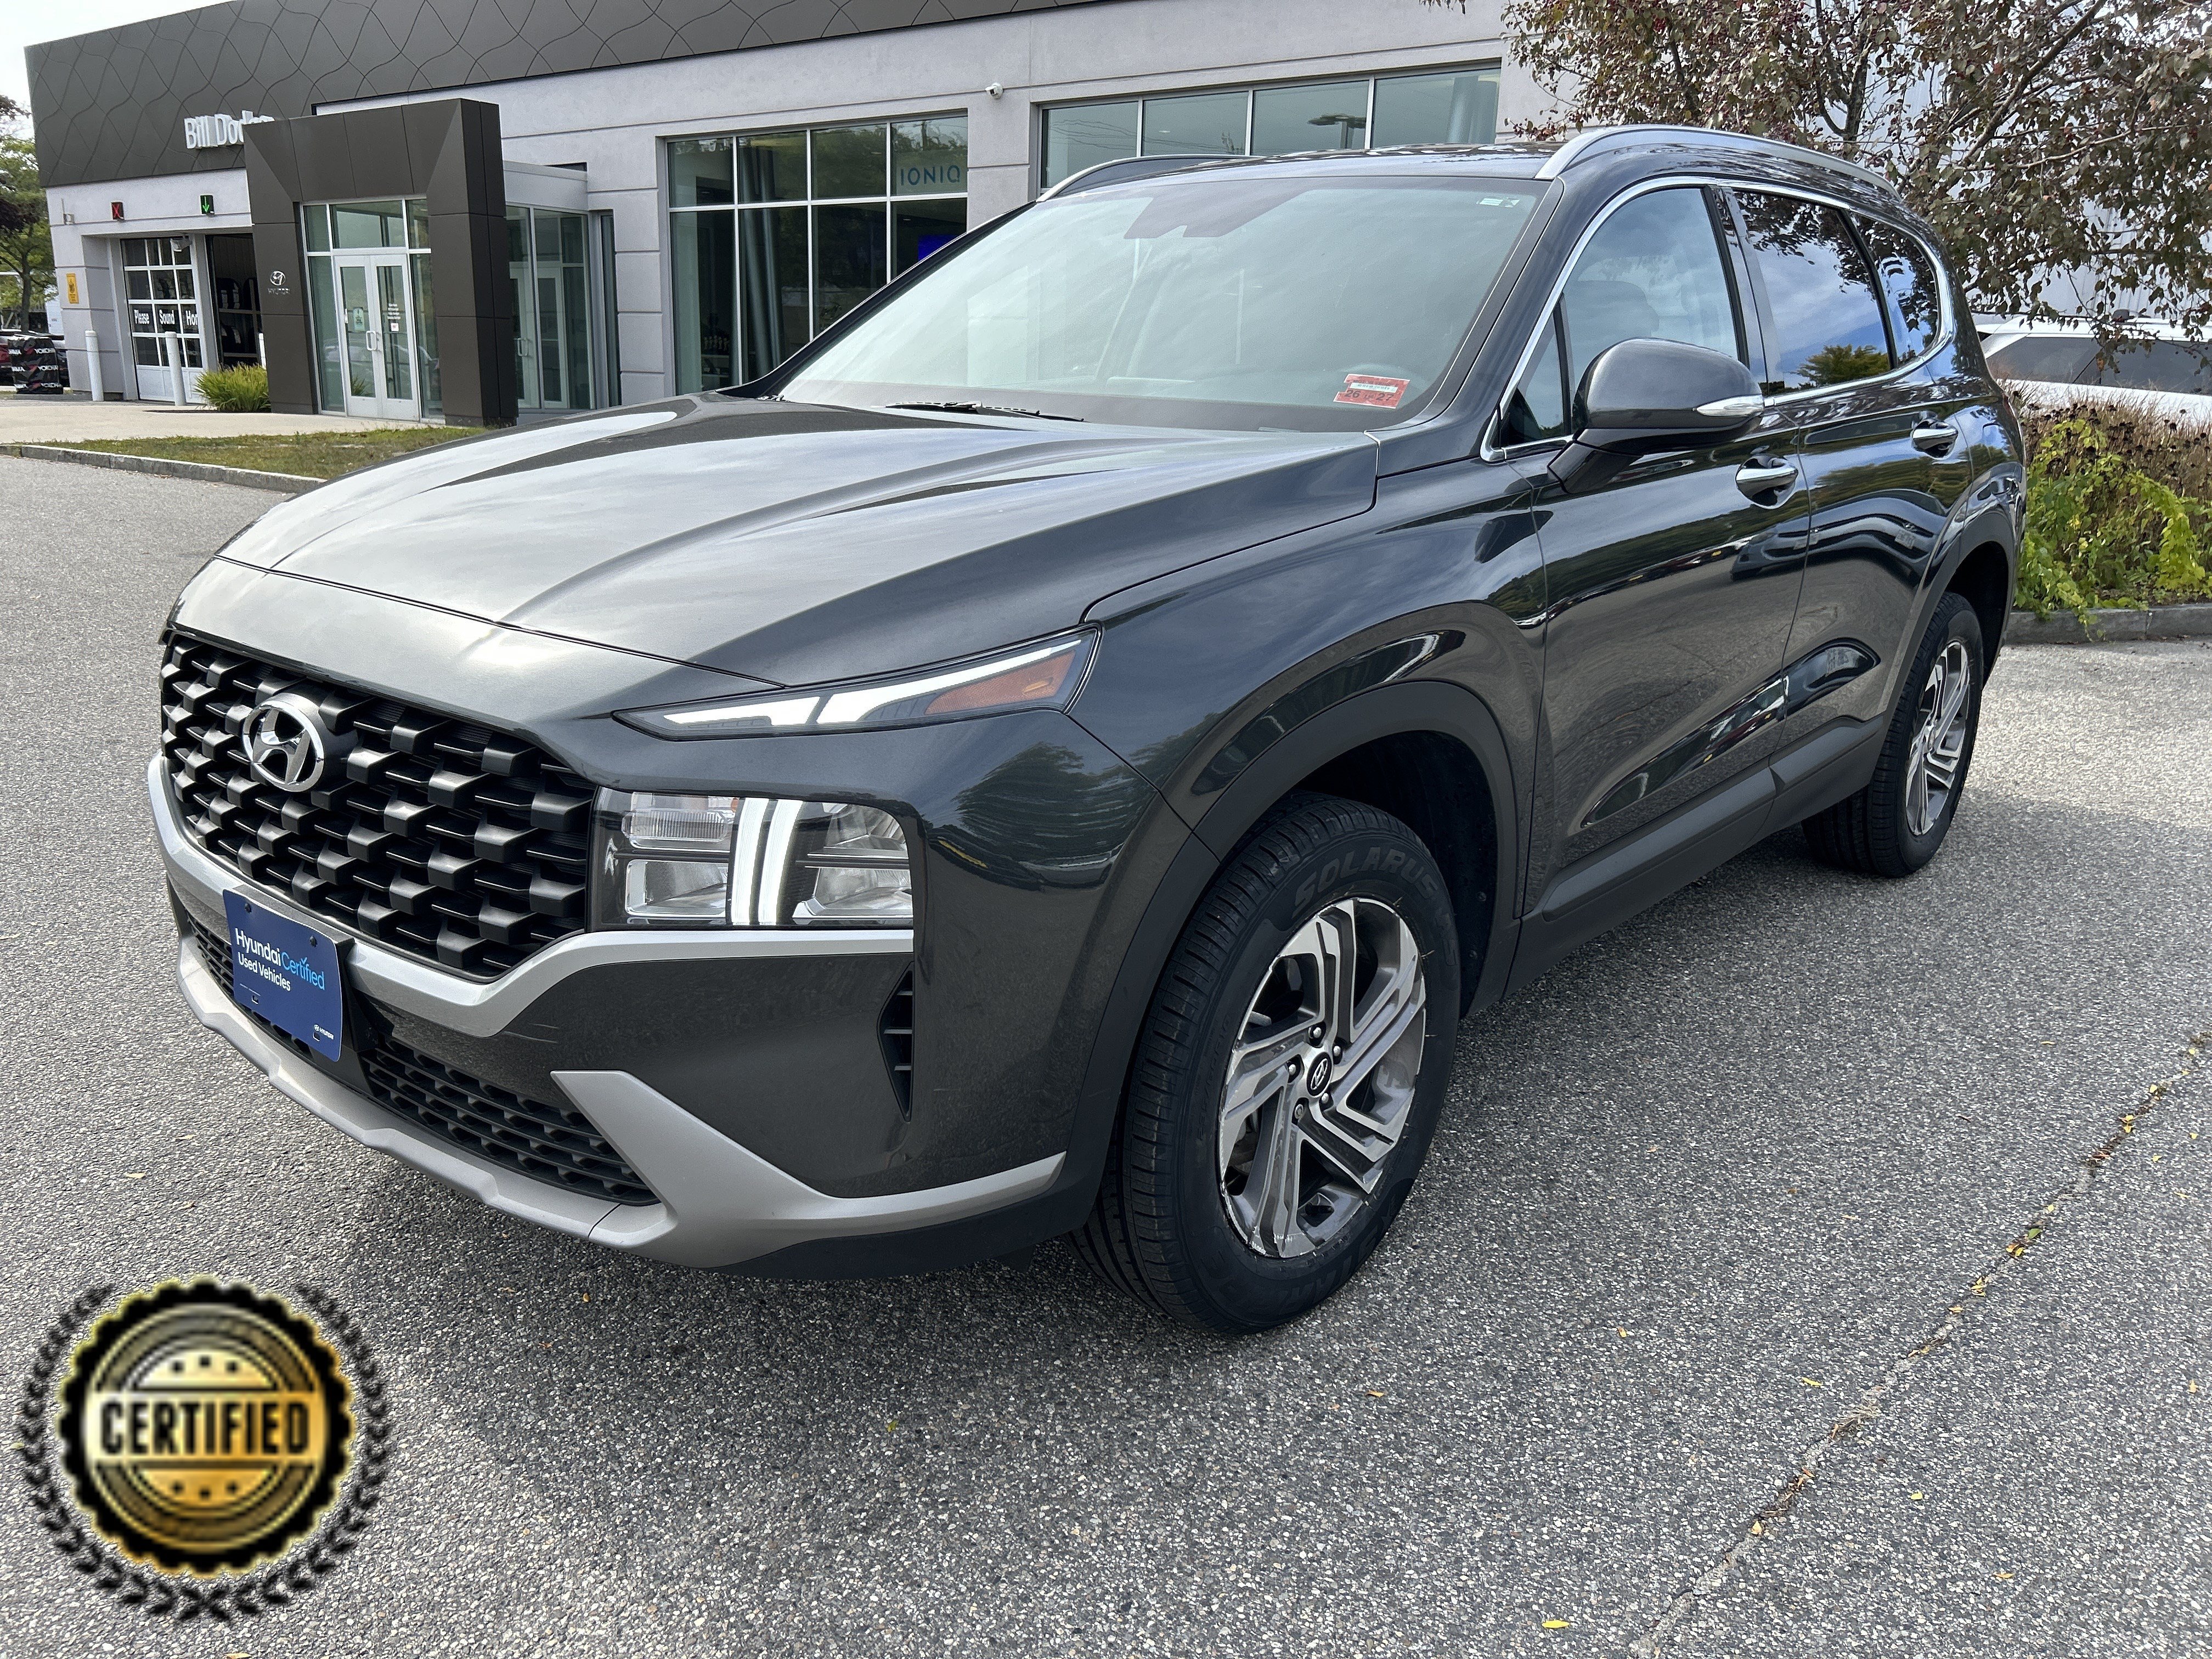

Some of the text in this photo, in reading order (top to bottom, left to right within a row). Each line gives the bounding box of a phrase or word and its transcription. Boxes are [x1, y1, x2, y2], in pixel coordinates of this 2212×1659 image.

[184, 110, 275, 149] Bill Dod
[900, 165, 961, 186] IONIQ
[133, 309, 198, 326] Please Sound Hor
[1344, 390, 1361, 398] 26
[1375, 393, 1395, 402] 27
[1291, 847, 1438, 919] SOLARUS
[235, 928, 325, 990] Hyundai Certified
[238, 952, 258, 973] Used
[258, 961, 291, 991] Vehicles
